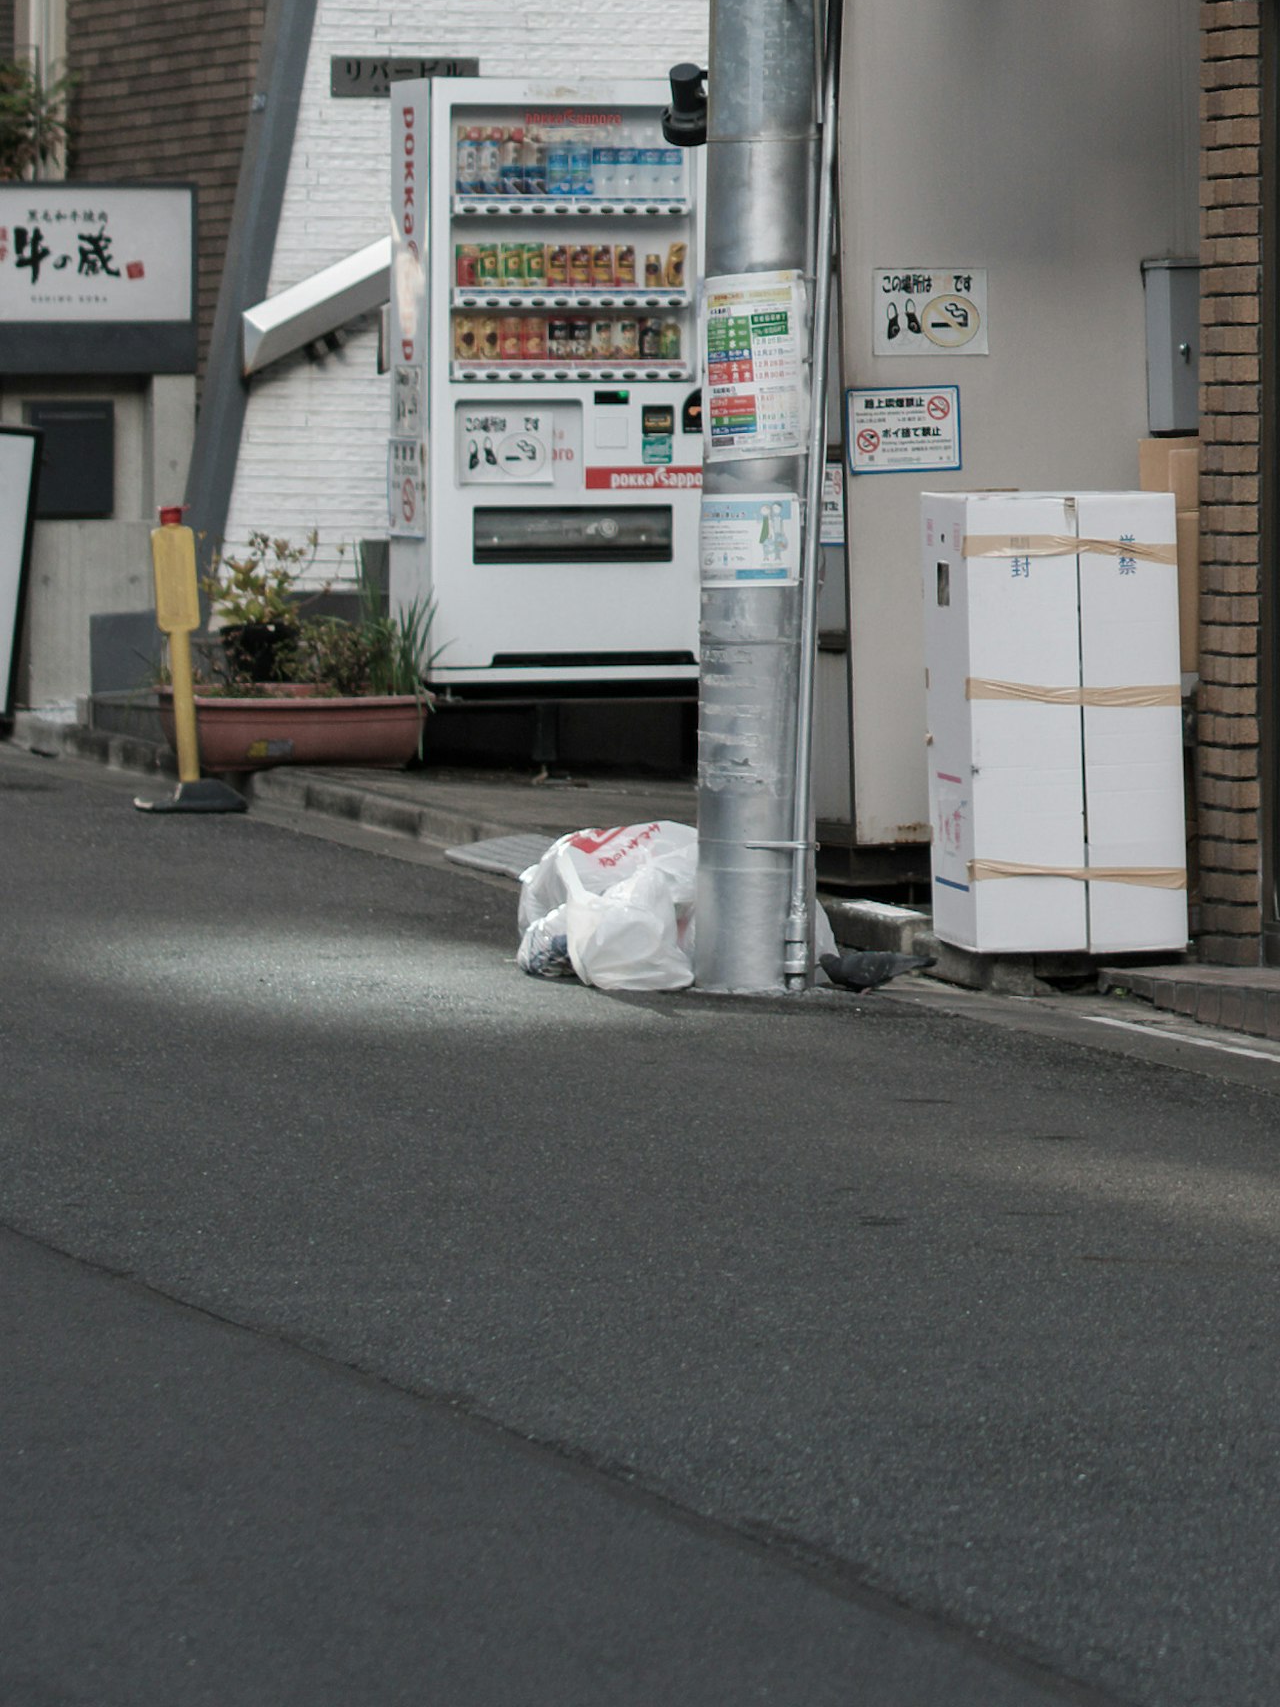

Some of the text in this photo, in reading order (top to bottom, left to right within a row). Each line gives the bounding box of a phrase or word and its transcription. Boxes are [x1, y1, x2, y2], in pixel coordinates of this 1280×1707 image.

[346, 60, 464, 81] リバービル
[14, 224, 121, 286] 牛の蔵
[881, 426, 942, 439] ポイ捨て禁止
